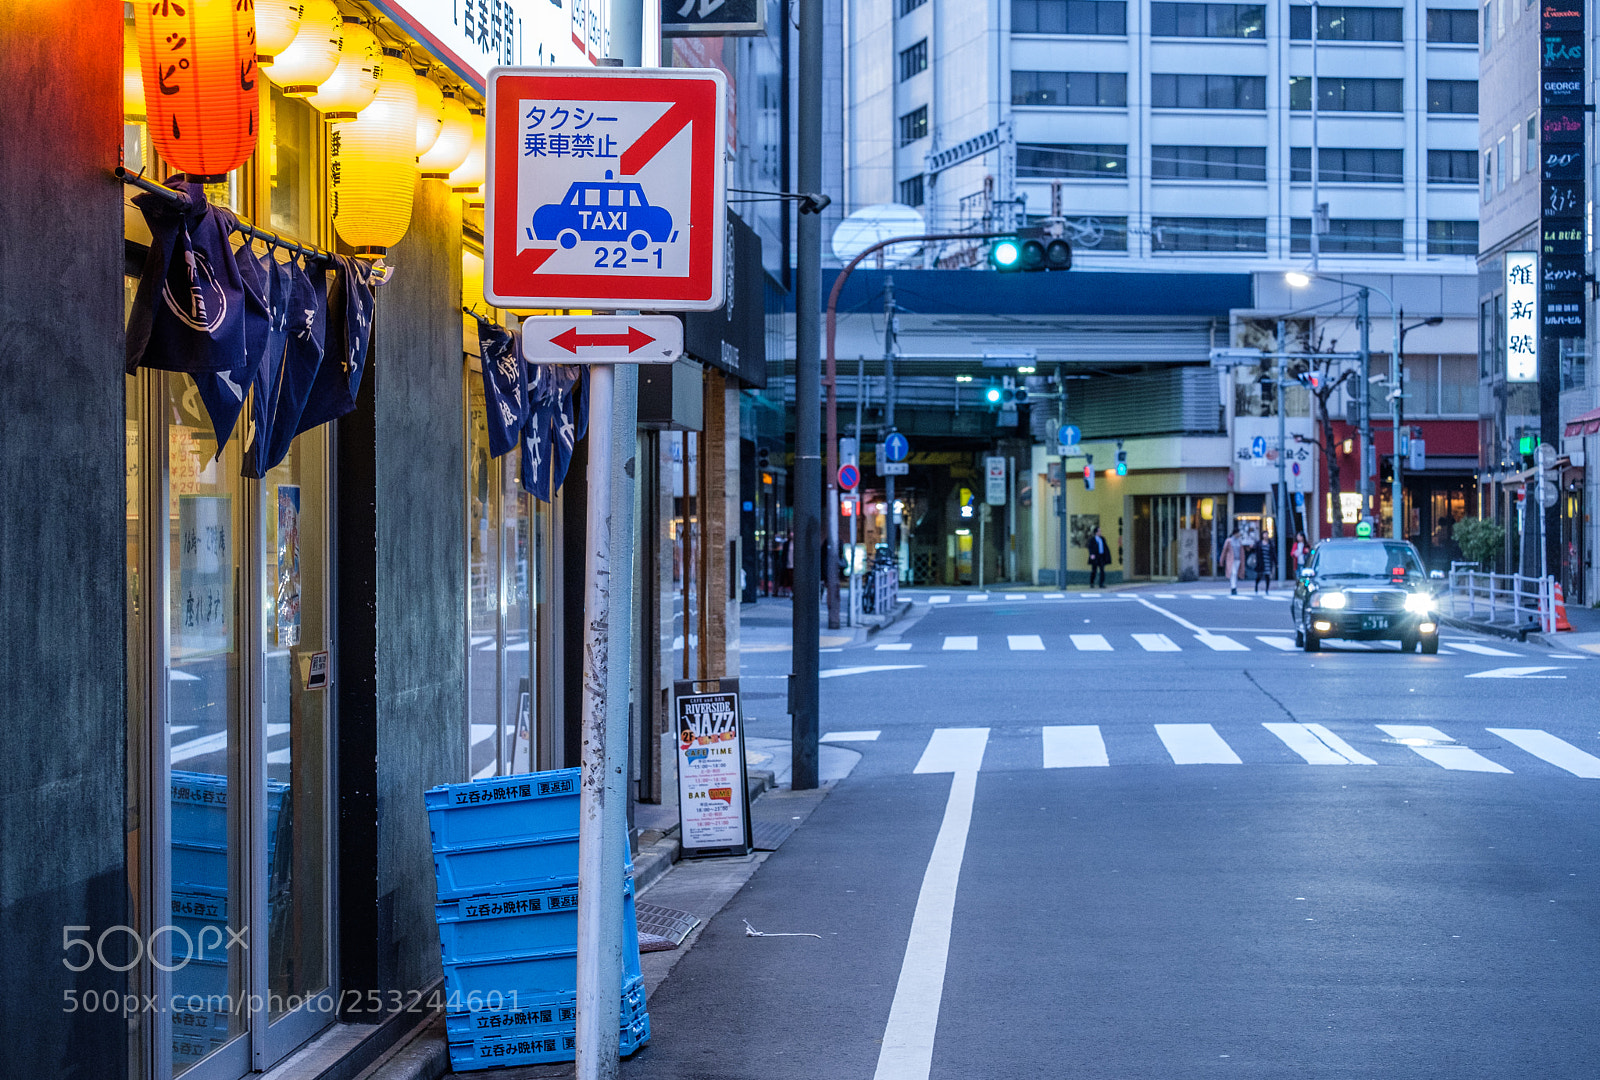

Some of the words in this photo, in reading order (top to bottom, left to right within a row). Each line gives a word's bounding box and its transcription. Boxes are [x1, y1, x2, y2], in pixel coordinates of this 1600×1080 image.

[1544, 82, 1580, 91] GEORGE
[525, 106, 618, 130] タクシー
[524, 133, 618, 158] 乗車禁止
[578, 211, 627, 231] TAXI
[1544, 231, 1556, 241] LA
[594, 247, 663, 269] 22-1
[685, 702, 731, 714] RIVERSIDE
[690, 711, 736, 737] JAZZ
[683, 731, 695, 742] 2F
[685, 749, 707, 757] CAFE
[710, 747, 732, 755] TIME
[455, 784, 532, 804] 立呑み晩杯屋
[541, 780, 571, 794] 要返却
[688, 791, 706, 799] BAR
[710, 789, 731, 797] TIME
[465, 898, 542, 917] 立呑み晩杯屋
[476, 1009, 553, 1029] 立呑み晩杯屋
[480, 1039, 557, 1058] 立呑み晩杯屋
